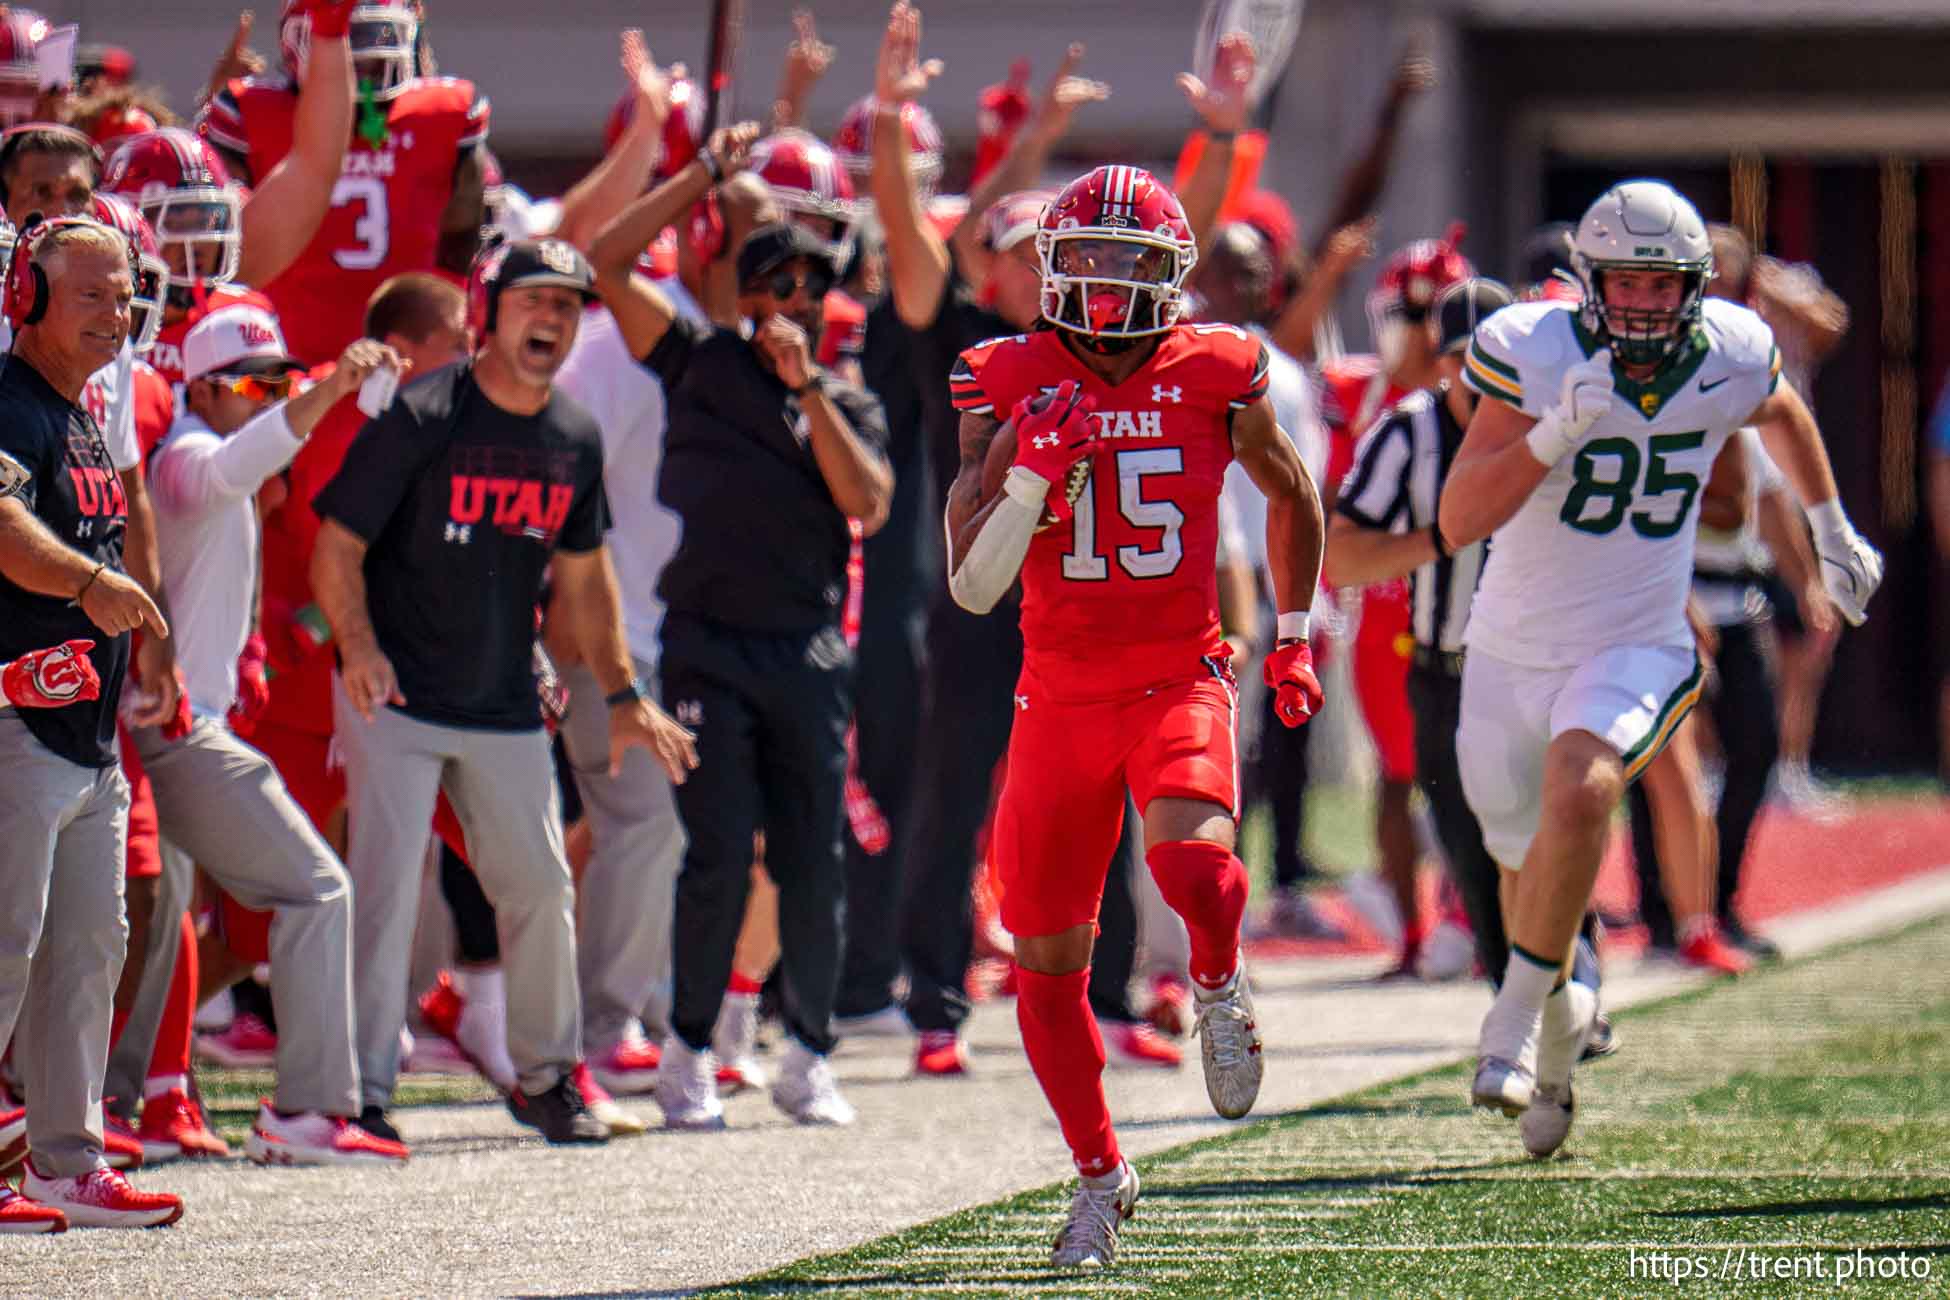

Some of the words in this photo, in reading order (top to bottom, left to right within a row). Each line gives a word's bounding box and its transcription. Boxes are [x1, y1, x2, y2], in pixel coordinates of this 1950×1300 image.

[340, 150, 395, 176] TAH
[329, 177, 390, 271] 3
[239, 322, 276, 347] Utes
[1089, 410, 1163, 439] TAH
[68, 466, 129, 517] UTA
[449, 475, 575, 533] UTAH
[1560, 429, 1708, 539] 85
[1061, 446, 1186, 581] 15
